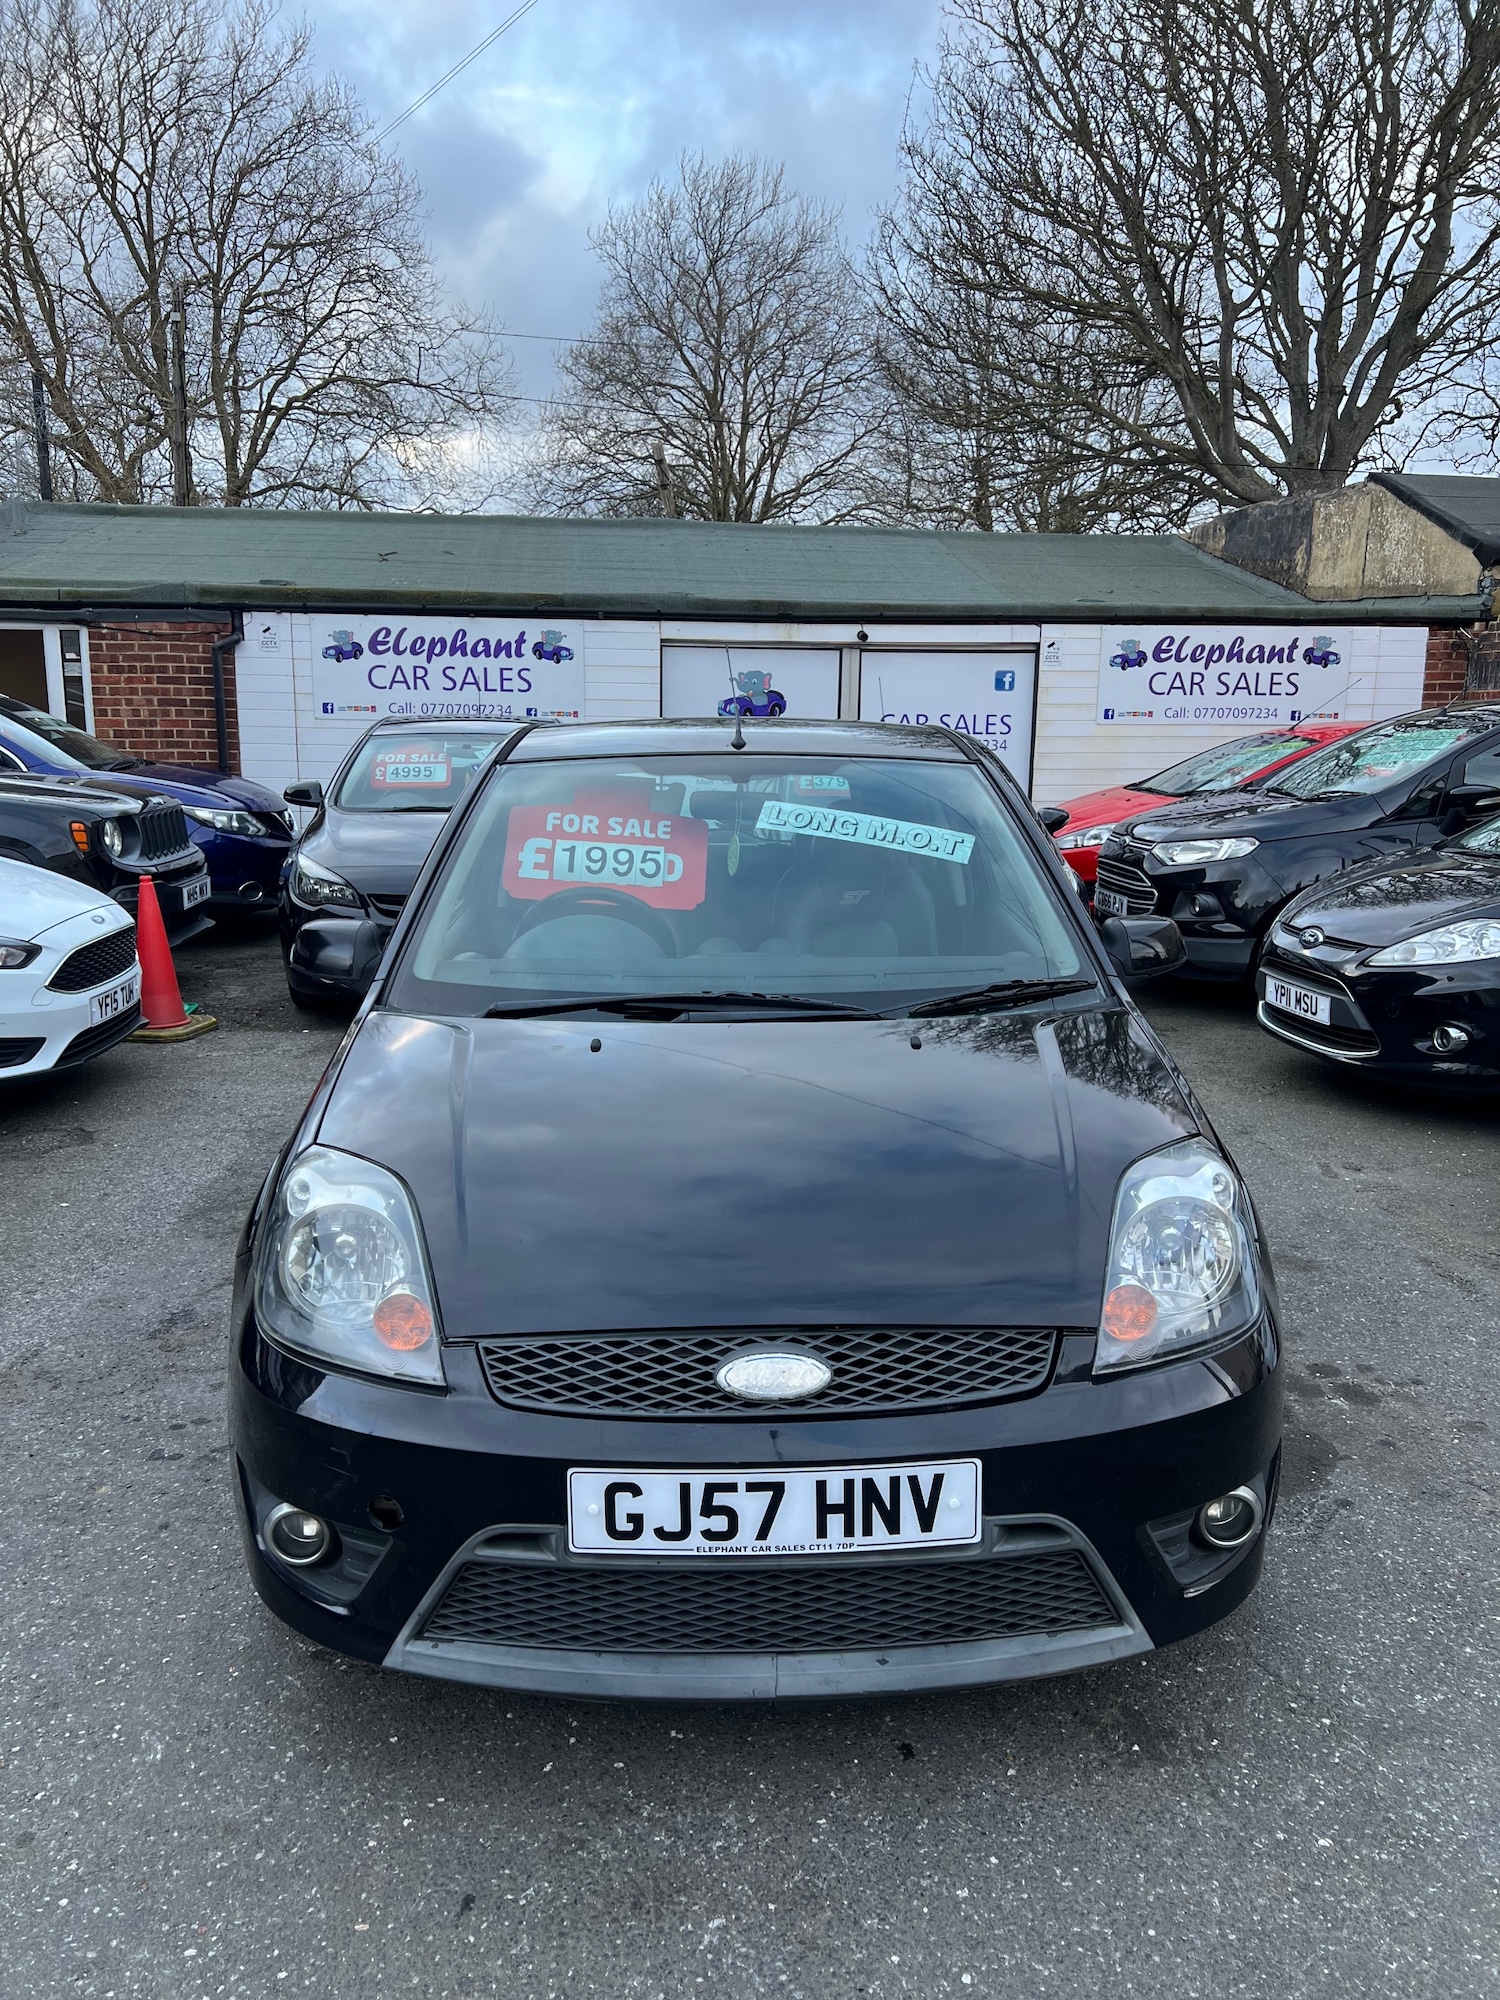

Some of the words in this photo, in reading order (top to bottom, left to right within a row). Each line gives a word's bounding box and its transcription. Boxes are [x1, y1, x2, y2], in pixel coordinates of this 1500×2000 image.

[368, 626, 527, 664] Elephant
[1152, 635, 1300, 670] Elephant
[368, 665, 430, 690] CAR
[442, 666, 532, 693] SALES
[1148, 671, 1205, 696] CAR
[1216, 672, 1299, 696] SALES
[388, 702, 416, 715] Call:
[420, 703, 513, 716] 07707097234
[1164, 707, 1190, 719] Call:
[1193, 707, 1278, 719] 07707097234
[939, 714, 1012, 735] SALES
[376, 754, 406, 763] FOR
[409, 753, 447, 763] SALE
[546, 812, 600, 835] FOR
[607, 816, 672, 840] SALE
[768, 805, 859, 837] LONG
[866, 820, 964, 856] M.O.T
[98, 990, 119, 1018] YF15
[120, 981, 134, 1007] TUH
[1274, 982, 1291, 1008] YP11
[1294, 990, 1318, 1016] MSU
[603, 1481, 786, 1542] GJ57
[815, 1473, 945, 1539] HNV
[751, 1545, 772, 1553] CAR
